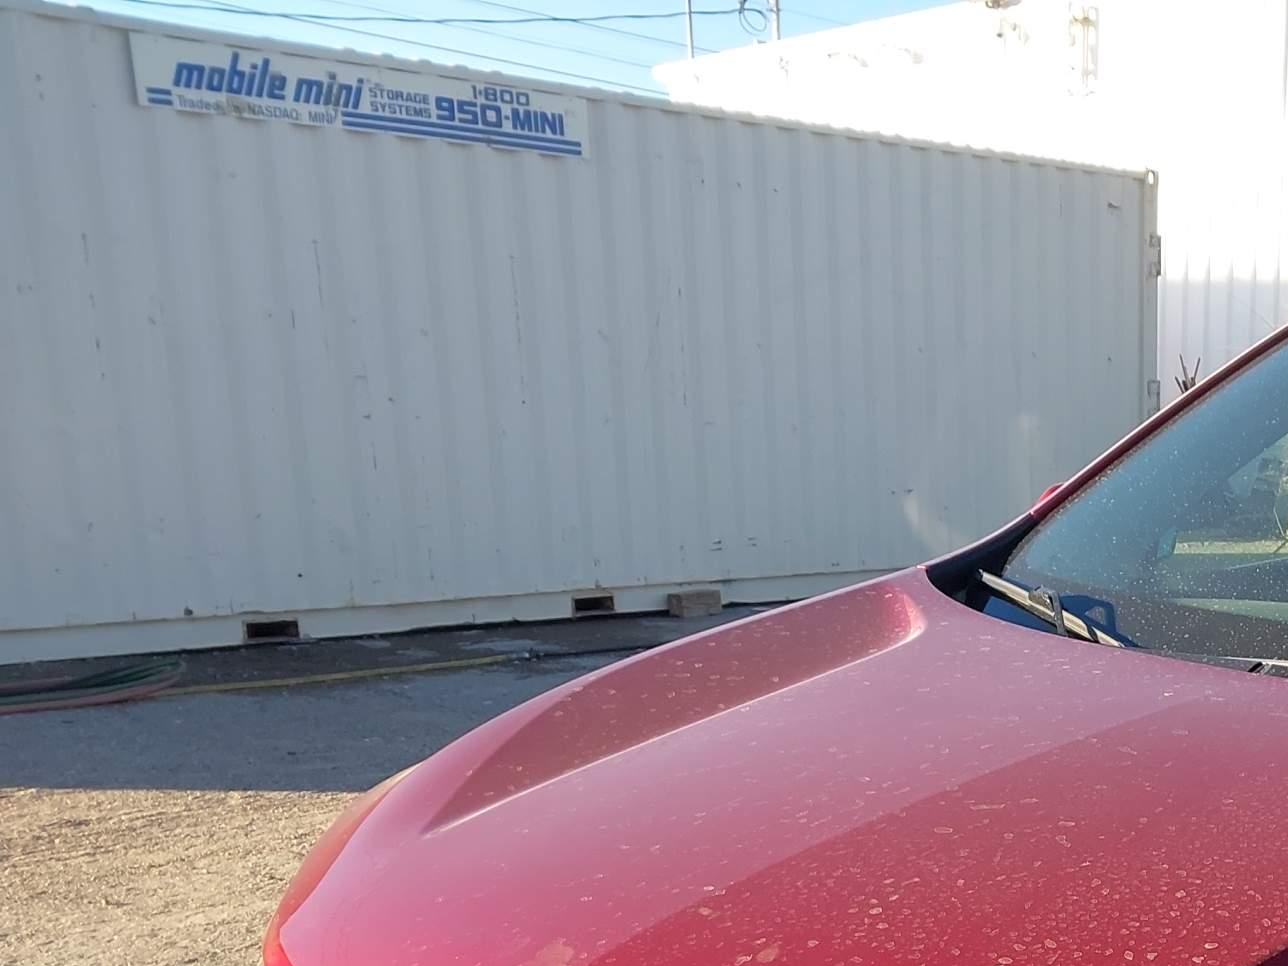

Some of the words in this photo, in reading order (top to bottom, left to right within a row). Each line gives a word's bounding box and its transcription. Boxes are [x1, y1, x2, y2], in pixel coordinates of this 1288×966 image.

[173, 51, 287, 101] mobile
[292, 71, 364, 110] mini
[368, 86, 430, 105] STORAGE
[369, 100, 432, 119] SYSTEMS
[434, 96, 565, 137] 950-MINI
